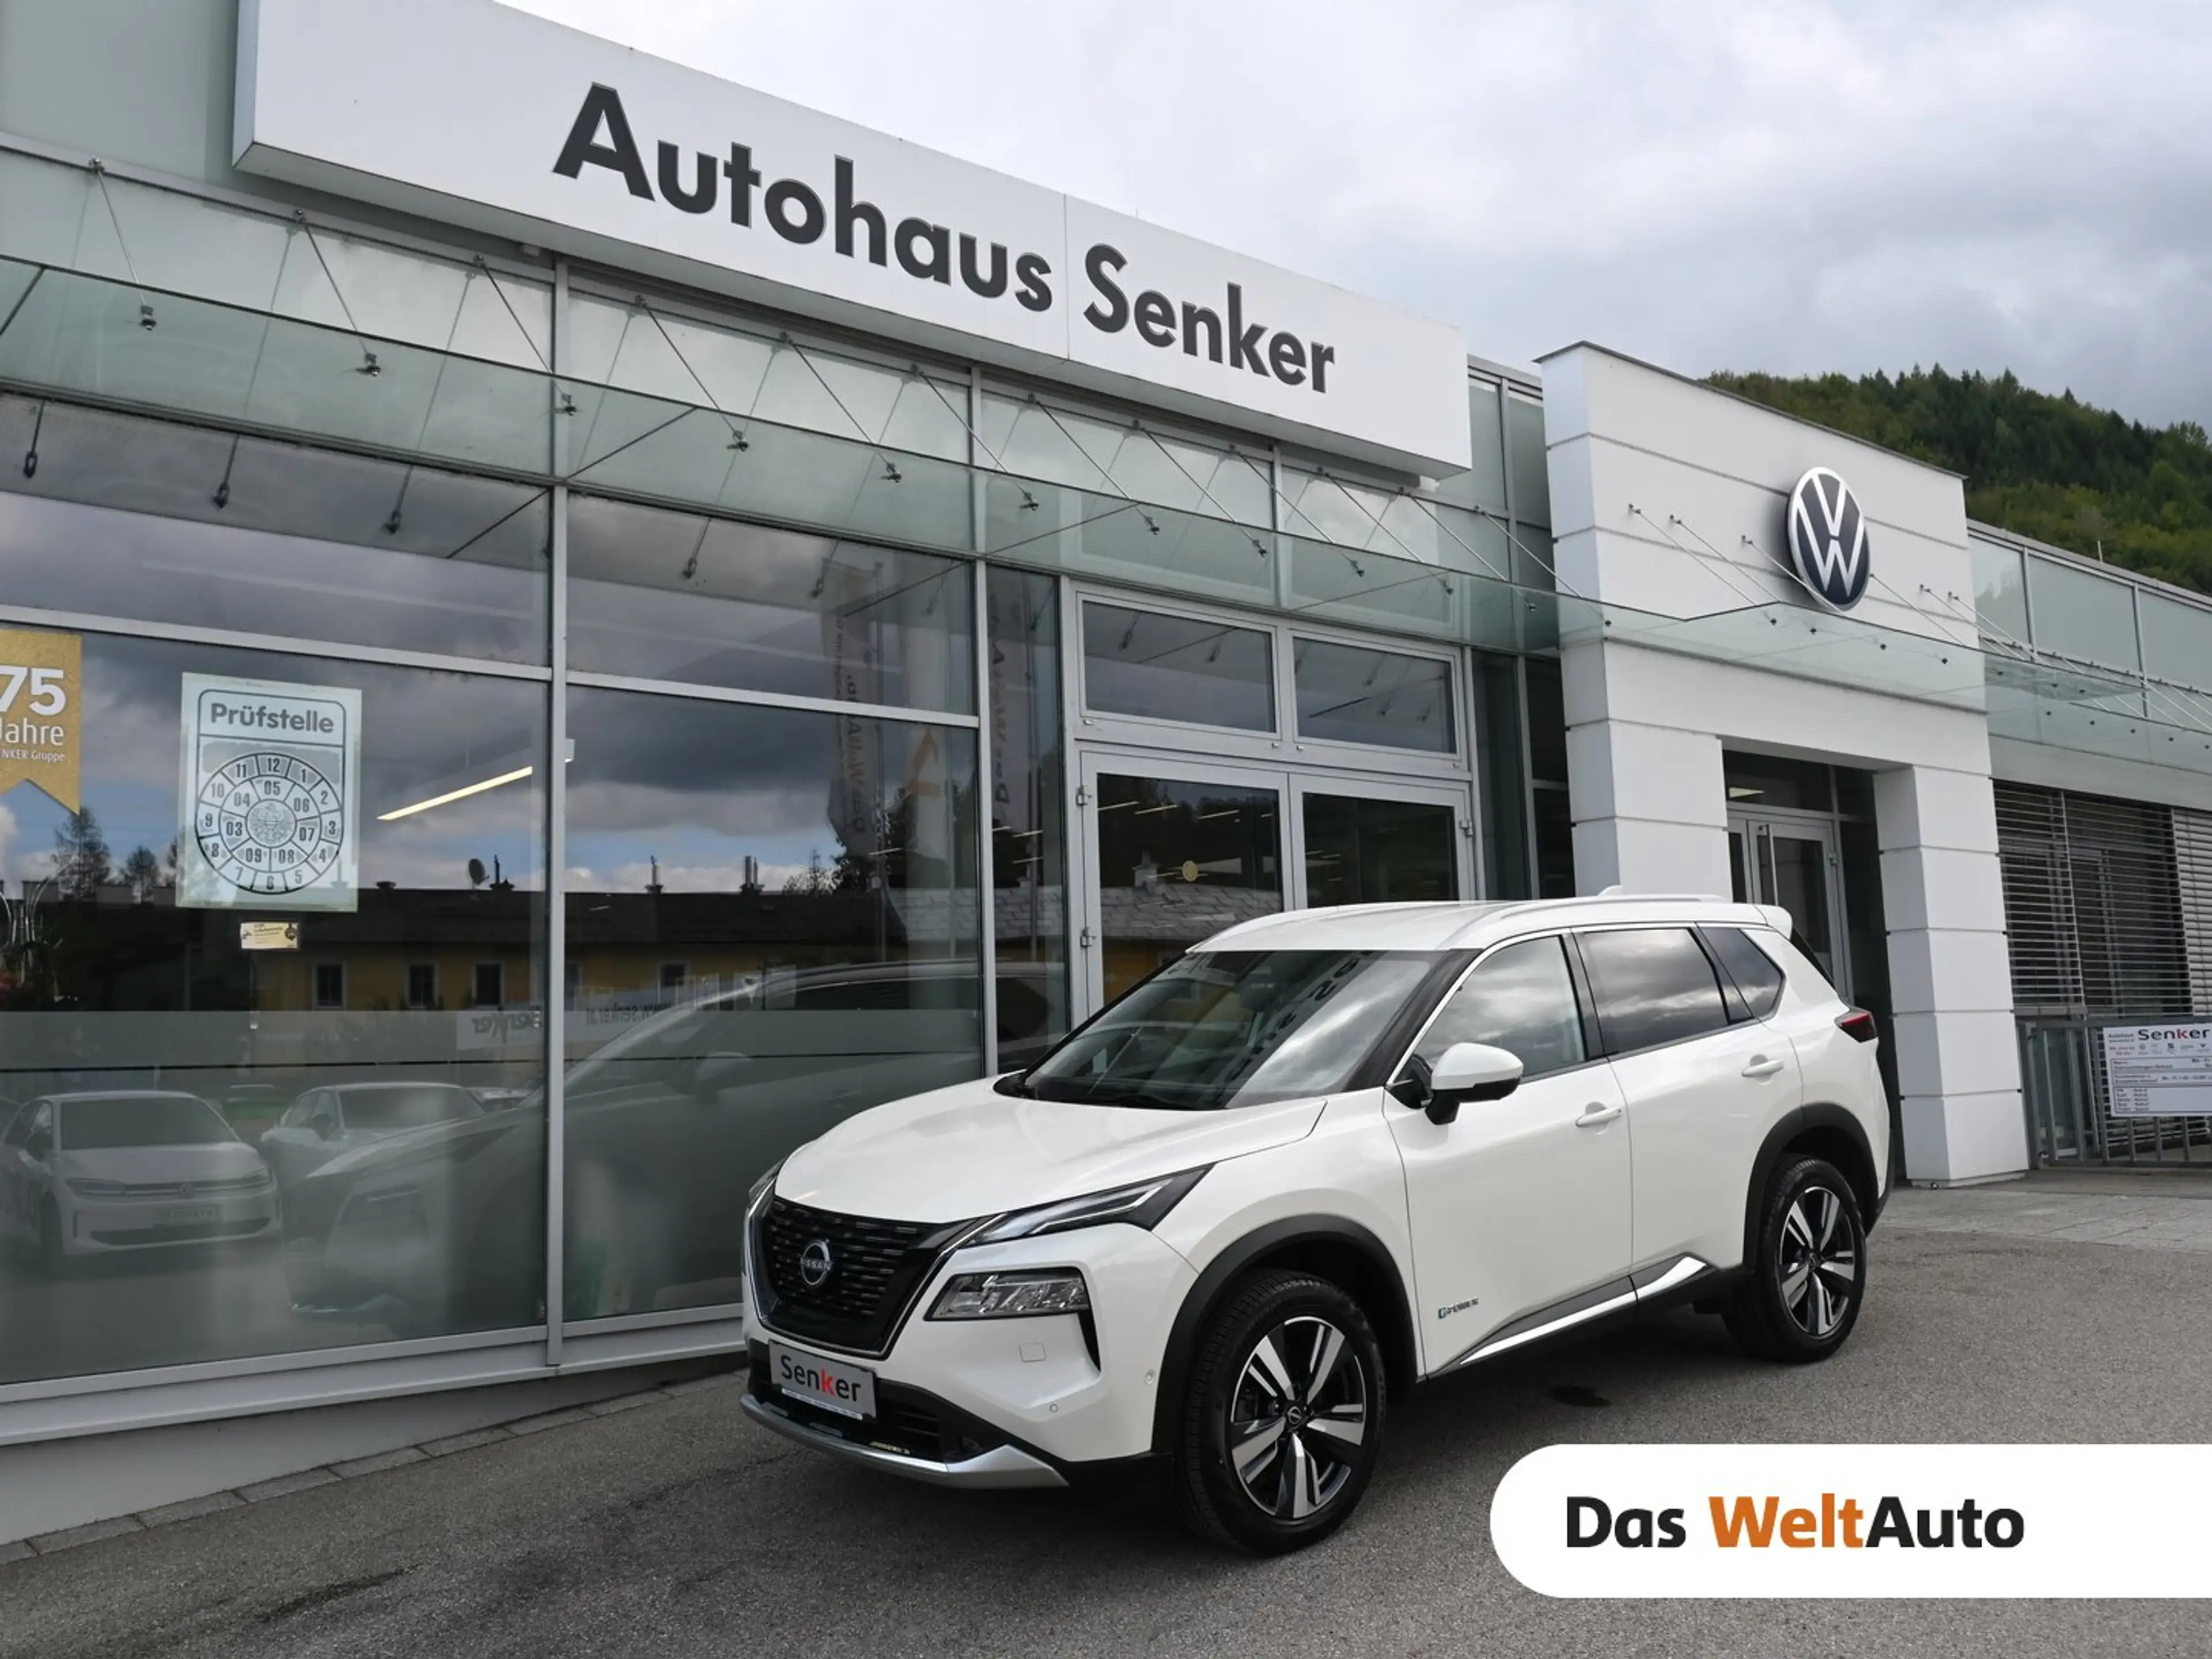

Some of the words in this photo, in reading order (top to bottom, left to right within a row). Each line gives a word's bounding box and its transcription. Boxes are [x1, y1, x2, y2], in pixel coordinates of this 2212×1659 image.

[552, 82, 1053, 312] Autohaus
[1084, 244, 1335, 393] Senker
[0, 665, 66, 715] 75
[210, 702, 334, 733] Prüfstelle
[32, 750, 65, 763] Gruppe
[236, 763, 247, 778] 11
[267, 757, 281, 772] 12
[301, 769, 306, 783] 1
[211, 783, 224, 798] 10
[264, 780, 280, 796] 05
[233, 792, 249, 807] 04
[320, 790, 328, 805] 2
[293, 798, 309, 813] 06
[205, 813, 213, 827] 9
[328, 820, 335, 835] 3
[226, 821, 243, 836] 03
[299, 827, 315, 842] 07
[211, 843, 219, 858] 8
[245, 848, 262, 863] 09
[278, 849, 294, 864] 08
[319, 849, 326, 863] 4
[235, 866, 243, 881] 7
[295, 870, 302, 884] 5
[267, 876, 274, 890] 6
[2138, 1028, 2210, 1041] Senker
[801, 1257, 833, 1272] SSAN
[781, 1354, 861, 1402] Senker
